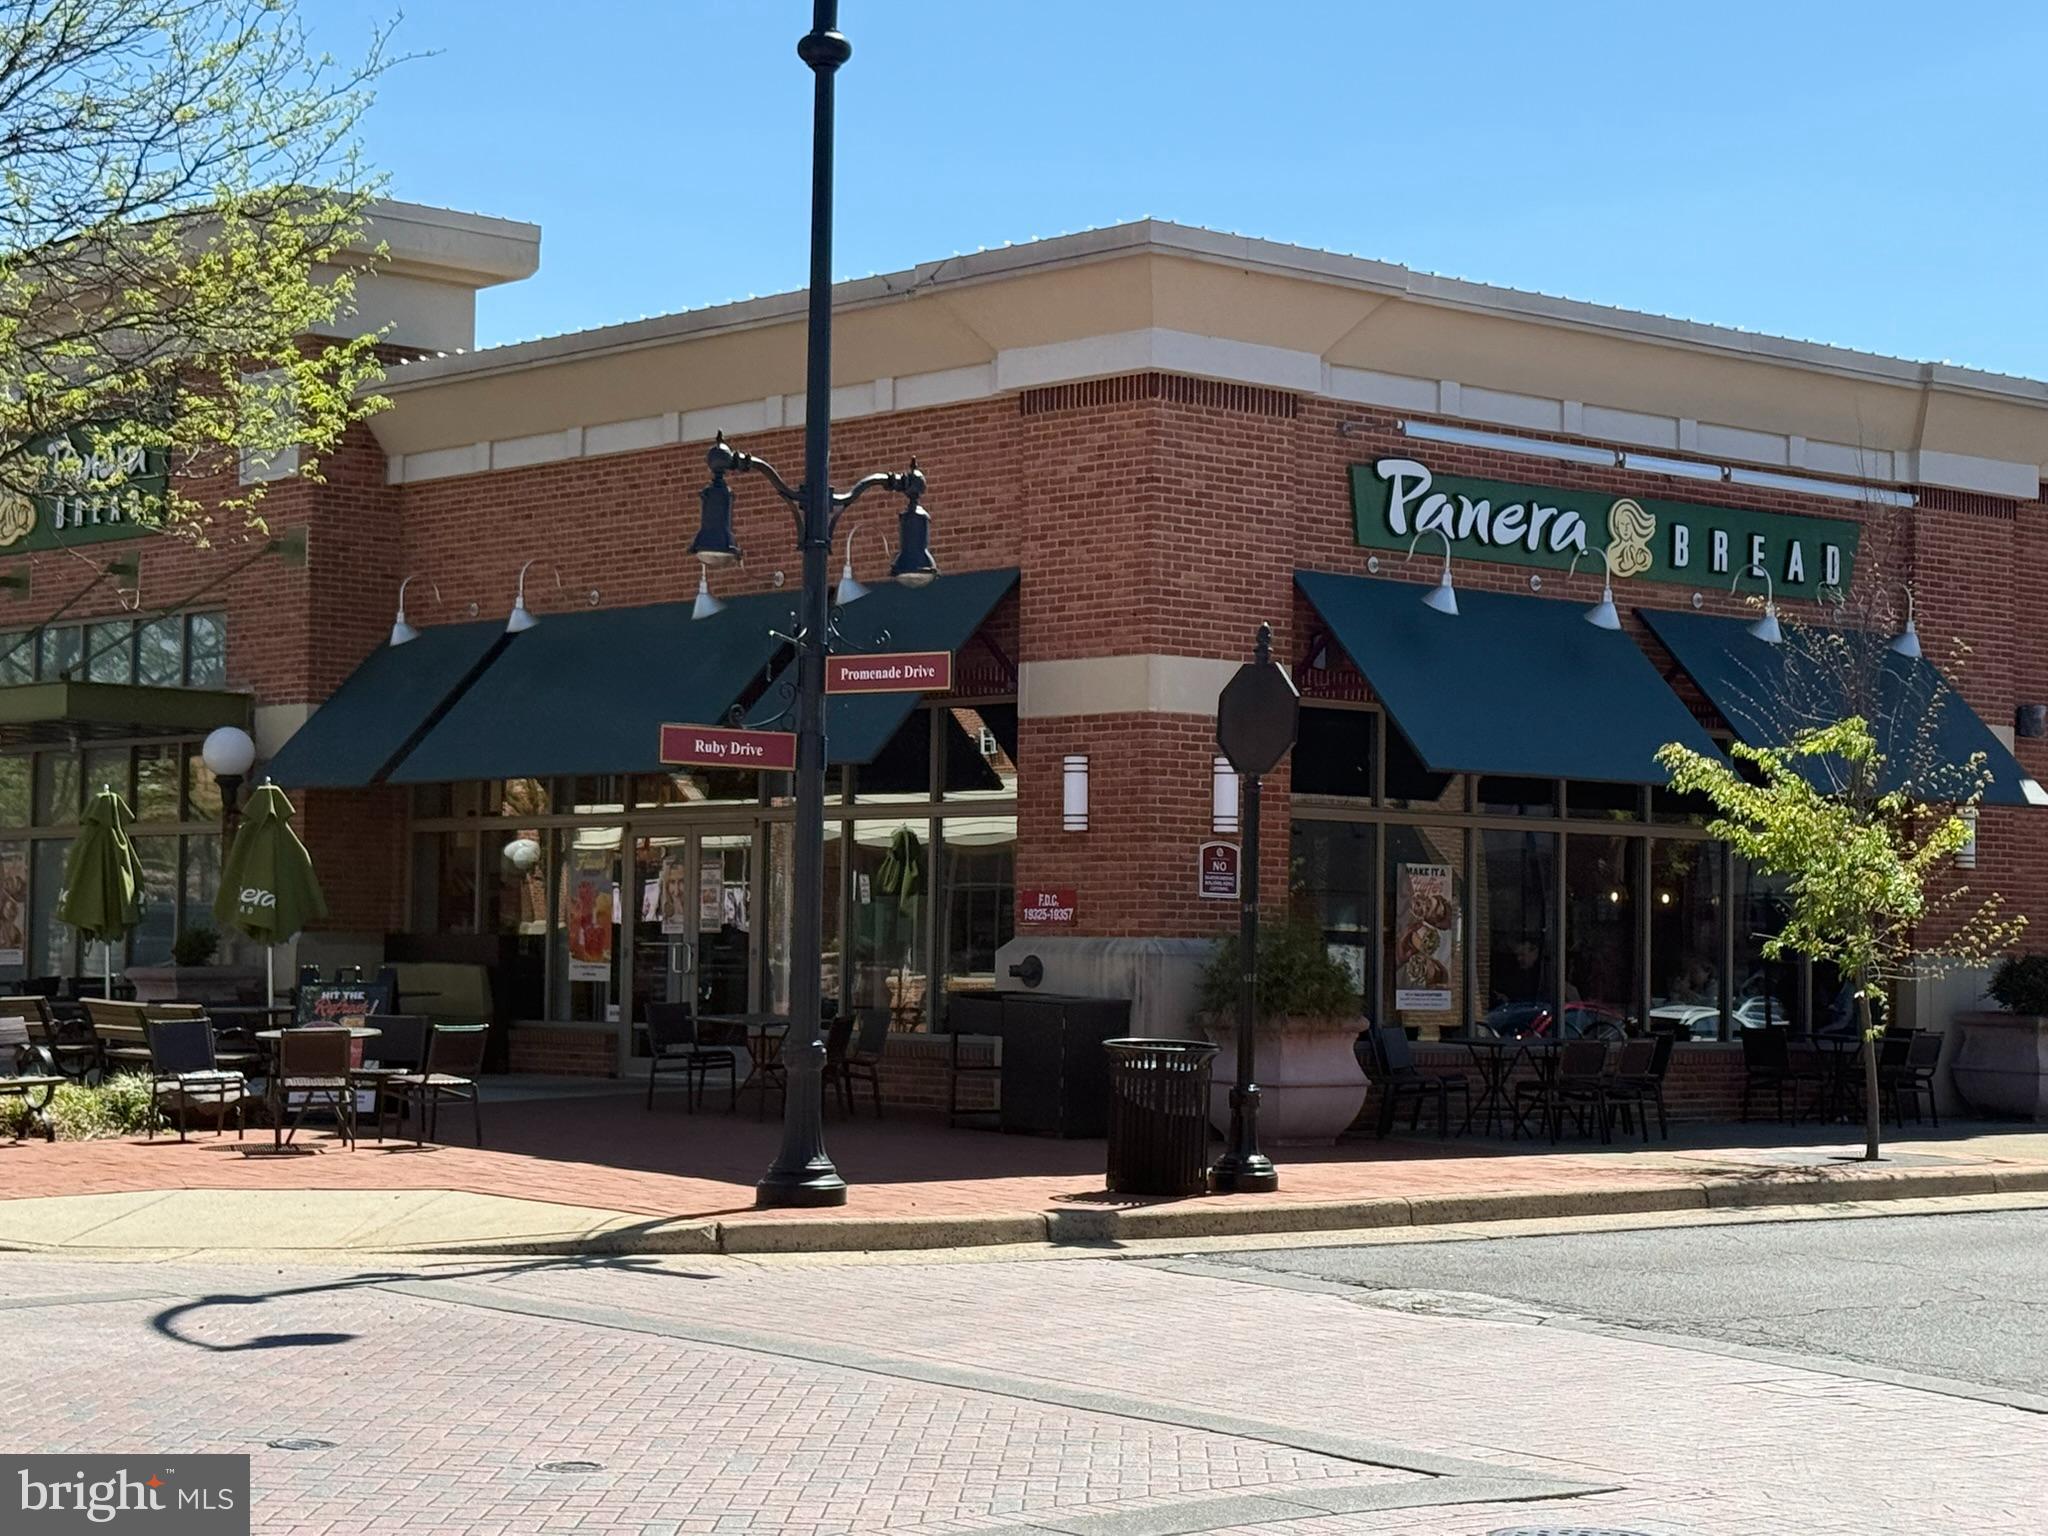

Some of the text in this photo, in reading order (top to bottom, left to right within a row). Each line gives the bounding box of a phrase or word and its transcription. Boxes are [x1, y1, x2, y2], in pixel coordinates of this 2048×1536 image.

[1375, 457, 1842, 587] Panera BREAD
[840, 664, 935, 681] Promenade Drive
[694, 739, 764, 757] Ruby Drive
[1212, 860, 1227, 872] NO
[1406, 867, 1429, 876] MAKE
[321, 991, 365, 1000] HIT THE
